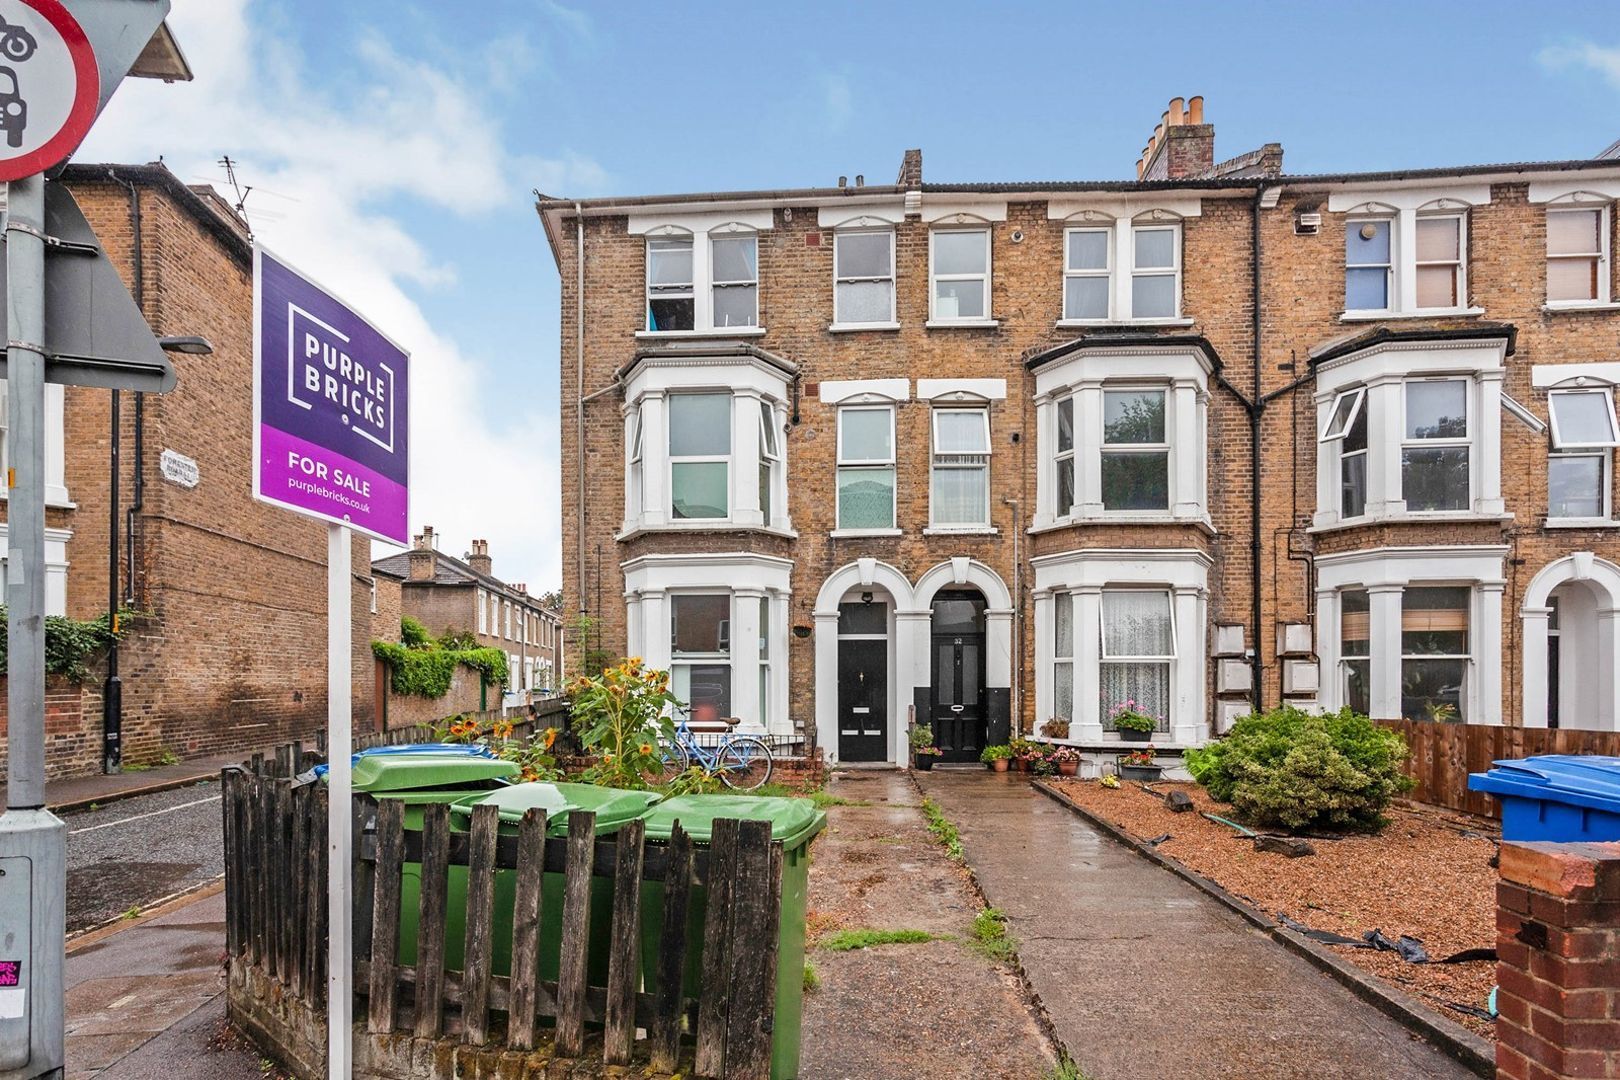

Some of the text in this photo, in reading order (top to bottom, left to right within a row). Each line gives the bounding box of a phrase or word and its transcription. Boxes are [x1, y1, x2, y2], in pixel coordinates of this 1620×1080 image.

[305, 332, 385, 403] PURPLE
[305, 363, 385, 430] BRICKS
[288, 451, 371, 498] FOR SALE
[288, 478, 370, 514] purplebricks.co.uk
